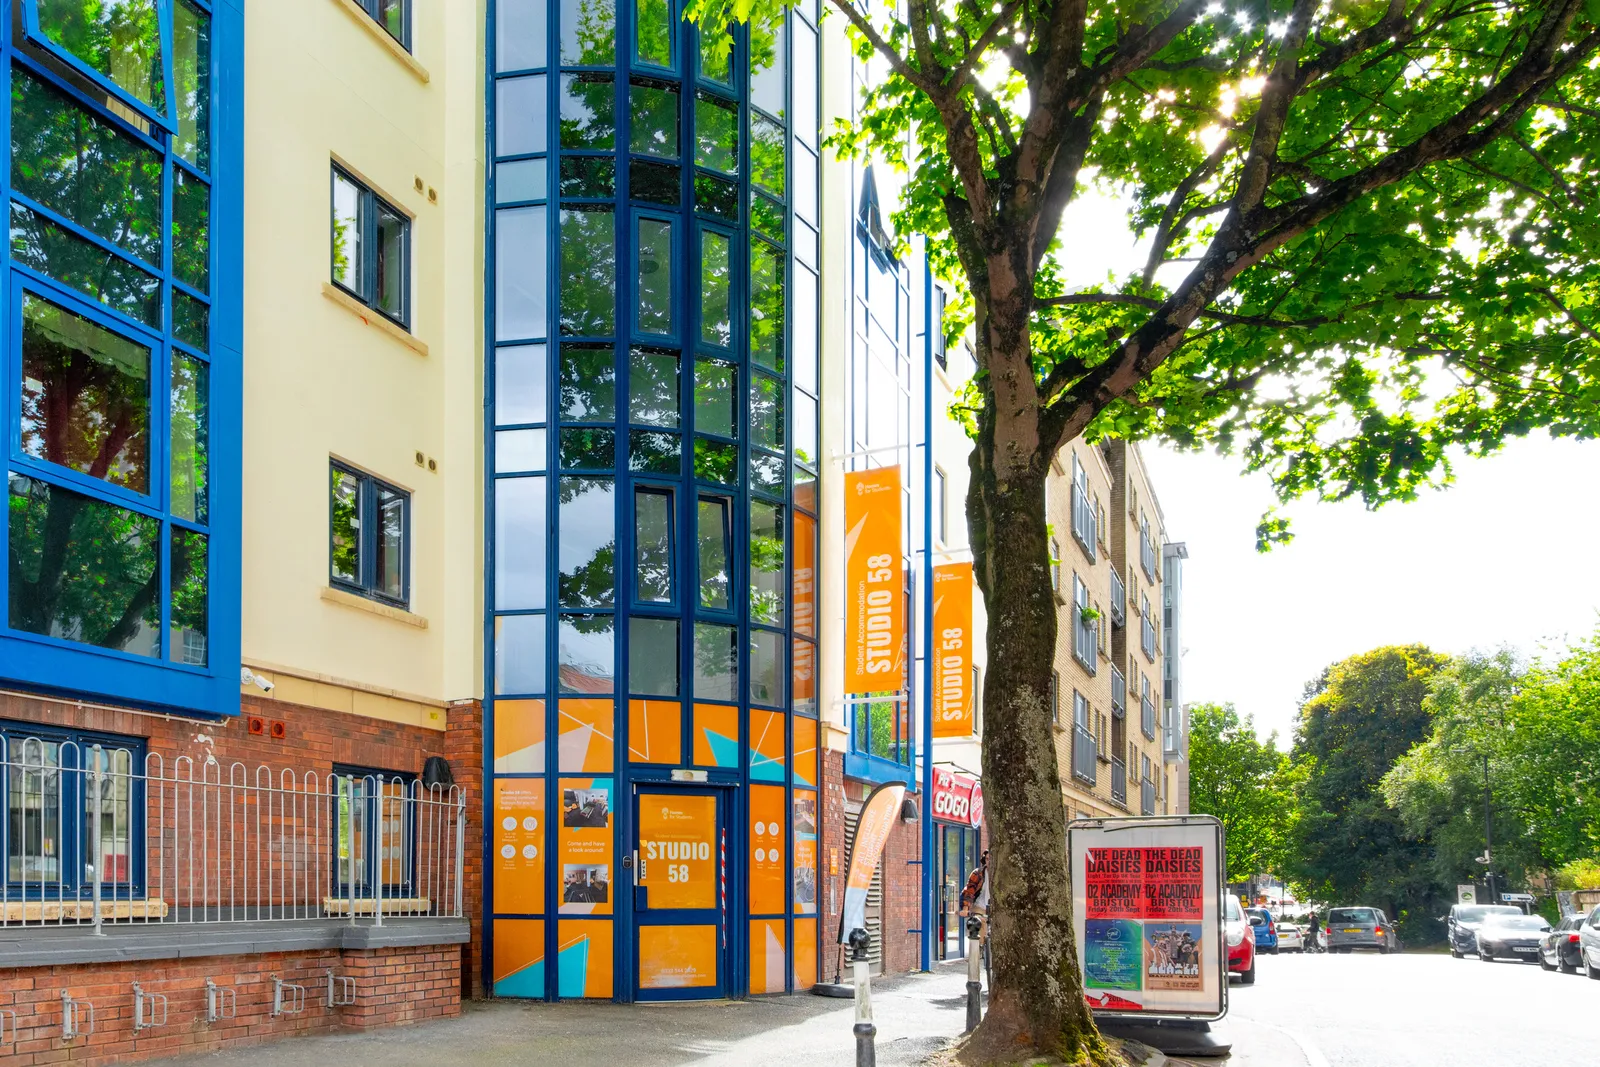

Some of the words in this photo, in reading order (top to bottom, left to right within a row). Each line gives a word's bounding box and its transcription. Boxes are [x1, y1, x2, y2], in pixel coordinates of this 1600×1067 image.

[867, 553, 892, 583] 58
[857, 580, 865, 644] Accommodation
[866, 590, 892, 674] STUDIO
[942, 627, 963, 650] 58
[856, 645, 864, 675] Student
[942, 655, 963, 721] STUDIO
[936, 791, 969, 817] GOGO
[647, 841, 709, 860] STUDIO
[1112, 850, 1141, 860] DEAD
[1146, 850, 1166, 860] THE
[1170, 850, 1200, 860] DEAD
[668, 864, 689, 883] 58
[1088, 860, 1141, 872] DAISIES
[1146, 860, 1200, 872] DAISIES
[1101, 884, 1141, 898] ACADEMY
[1158, 884, 1201, 898] ACADEMY
